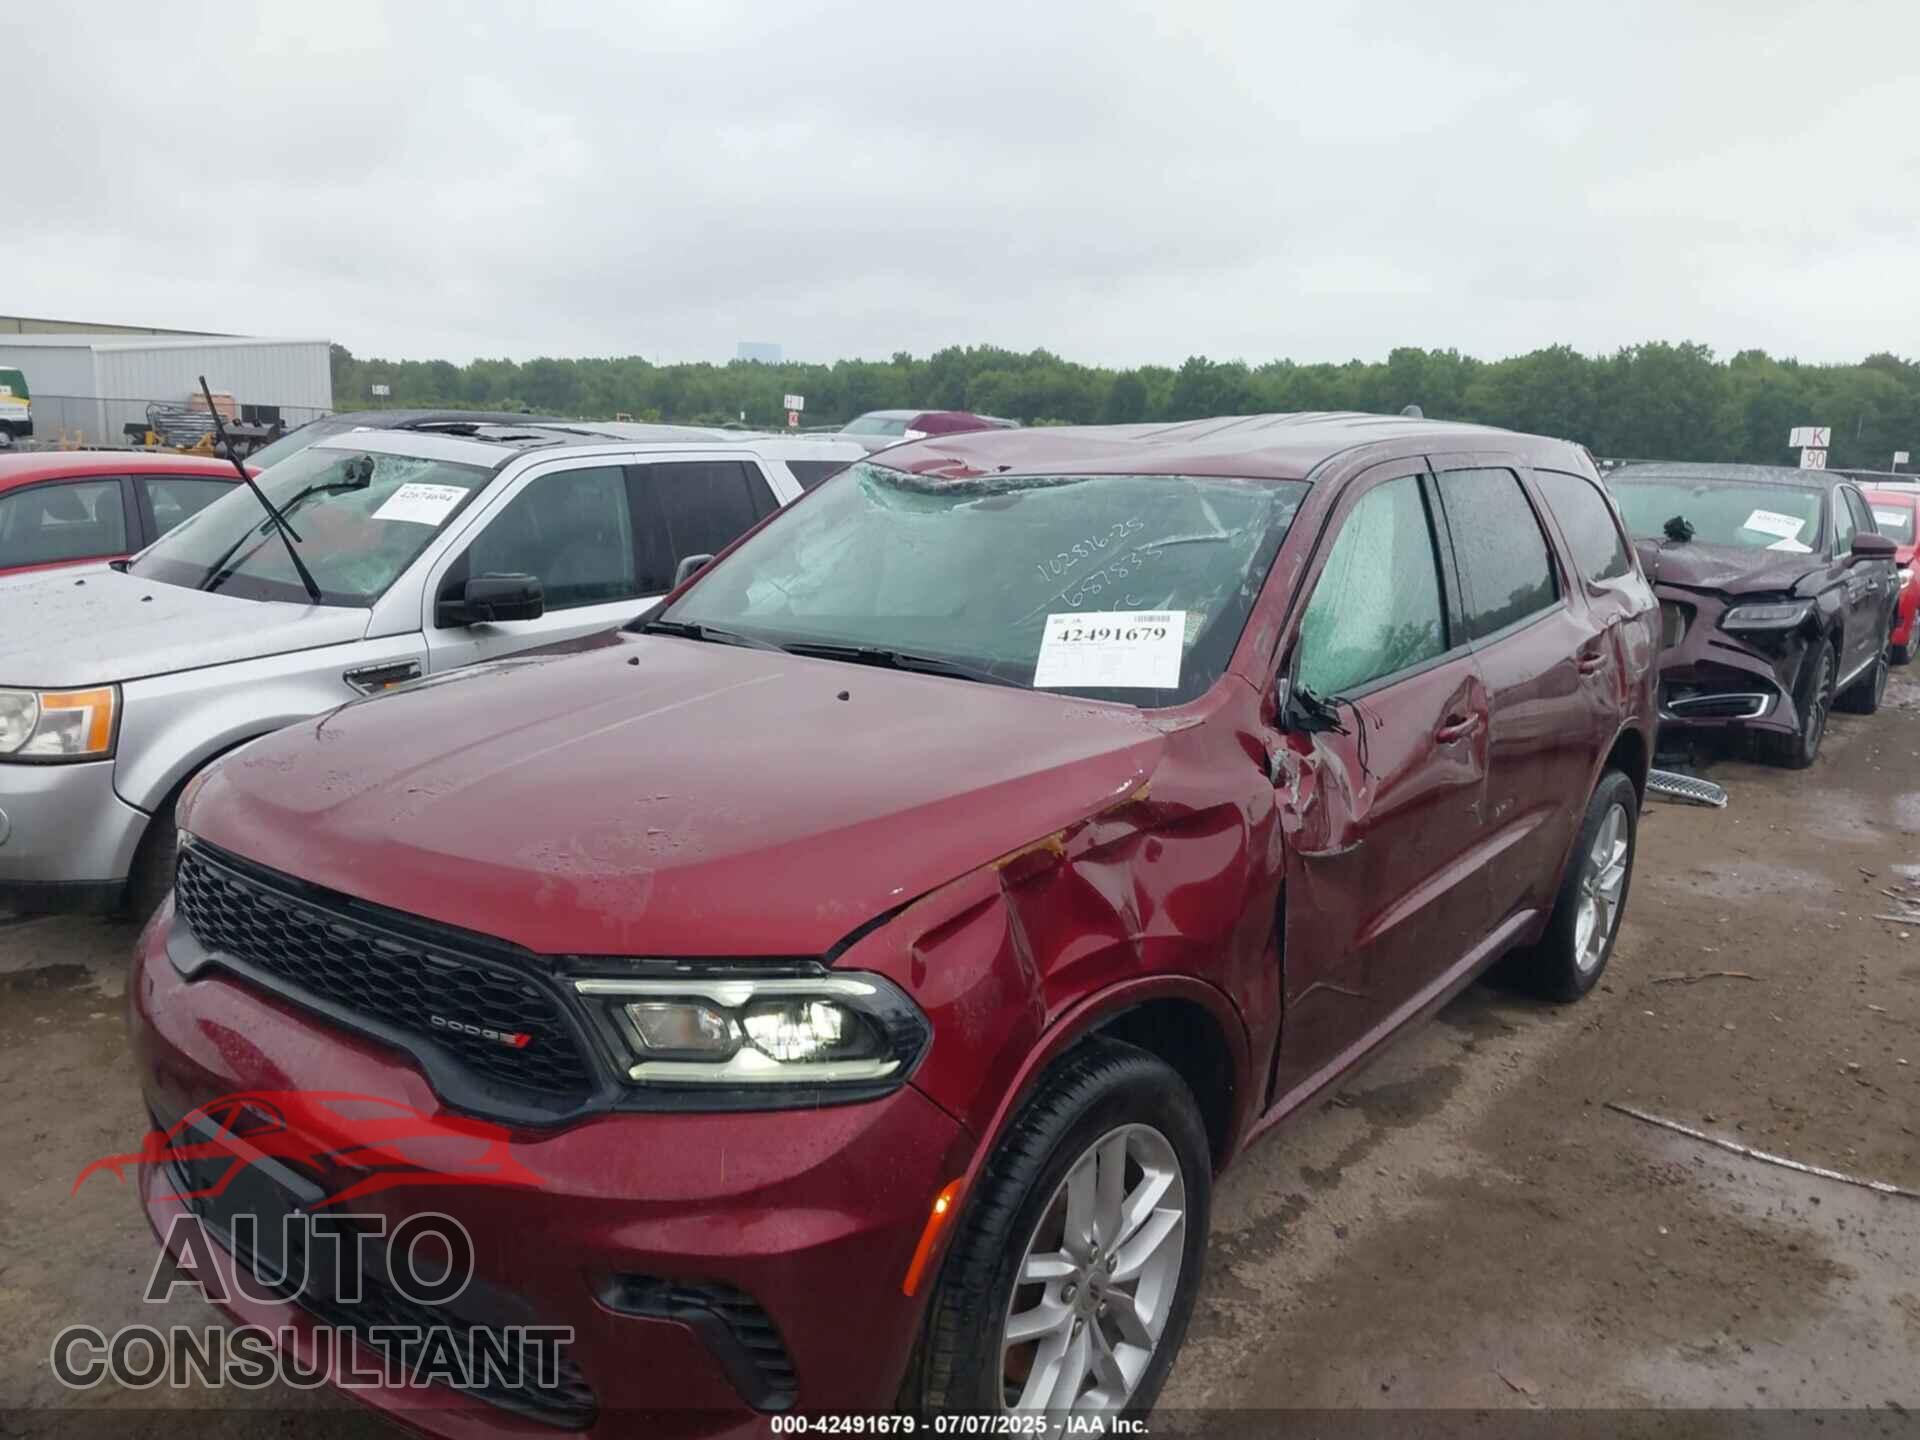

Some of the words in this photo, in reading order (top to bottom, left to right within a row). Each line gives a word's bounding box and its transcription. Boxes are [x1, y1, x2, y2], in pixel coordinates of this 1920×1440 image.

[1812, 428, 1824, 446] K
[1807, 450, 1825, 469] 90
[1056, 627, 1166, 642] 42491679
